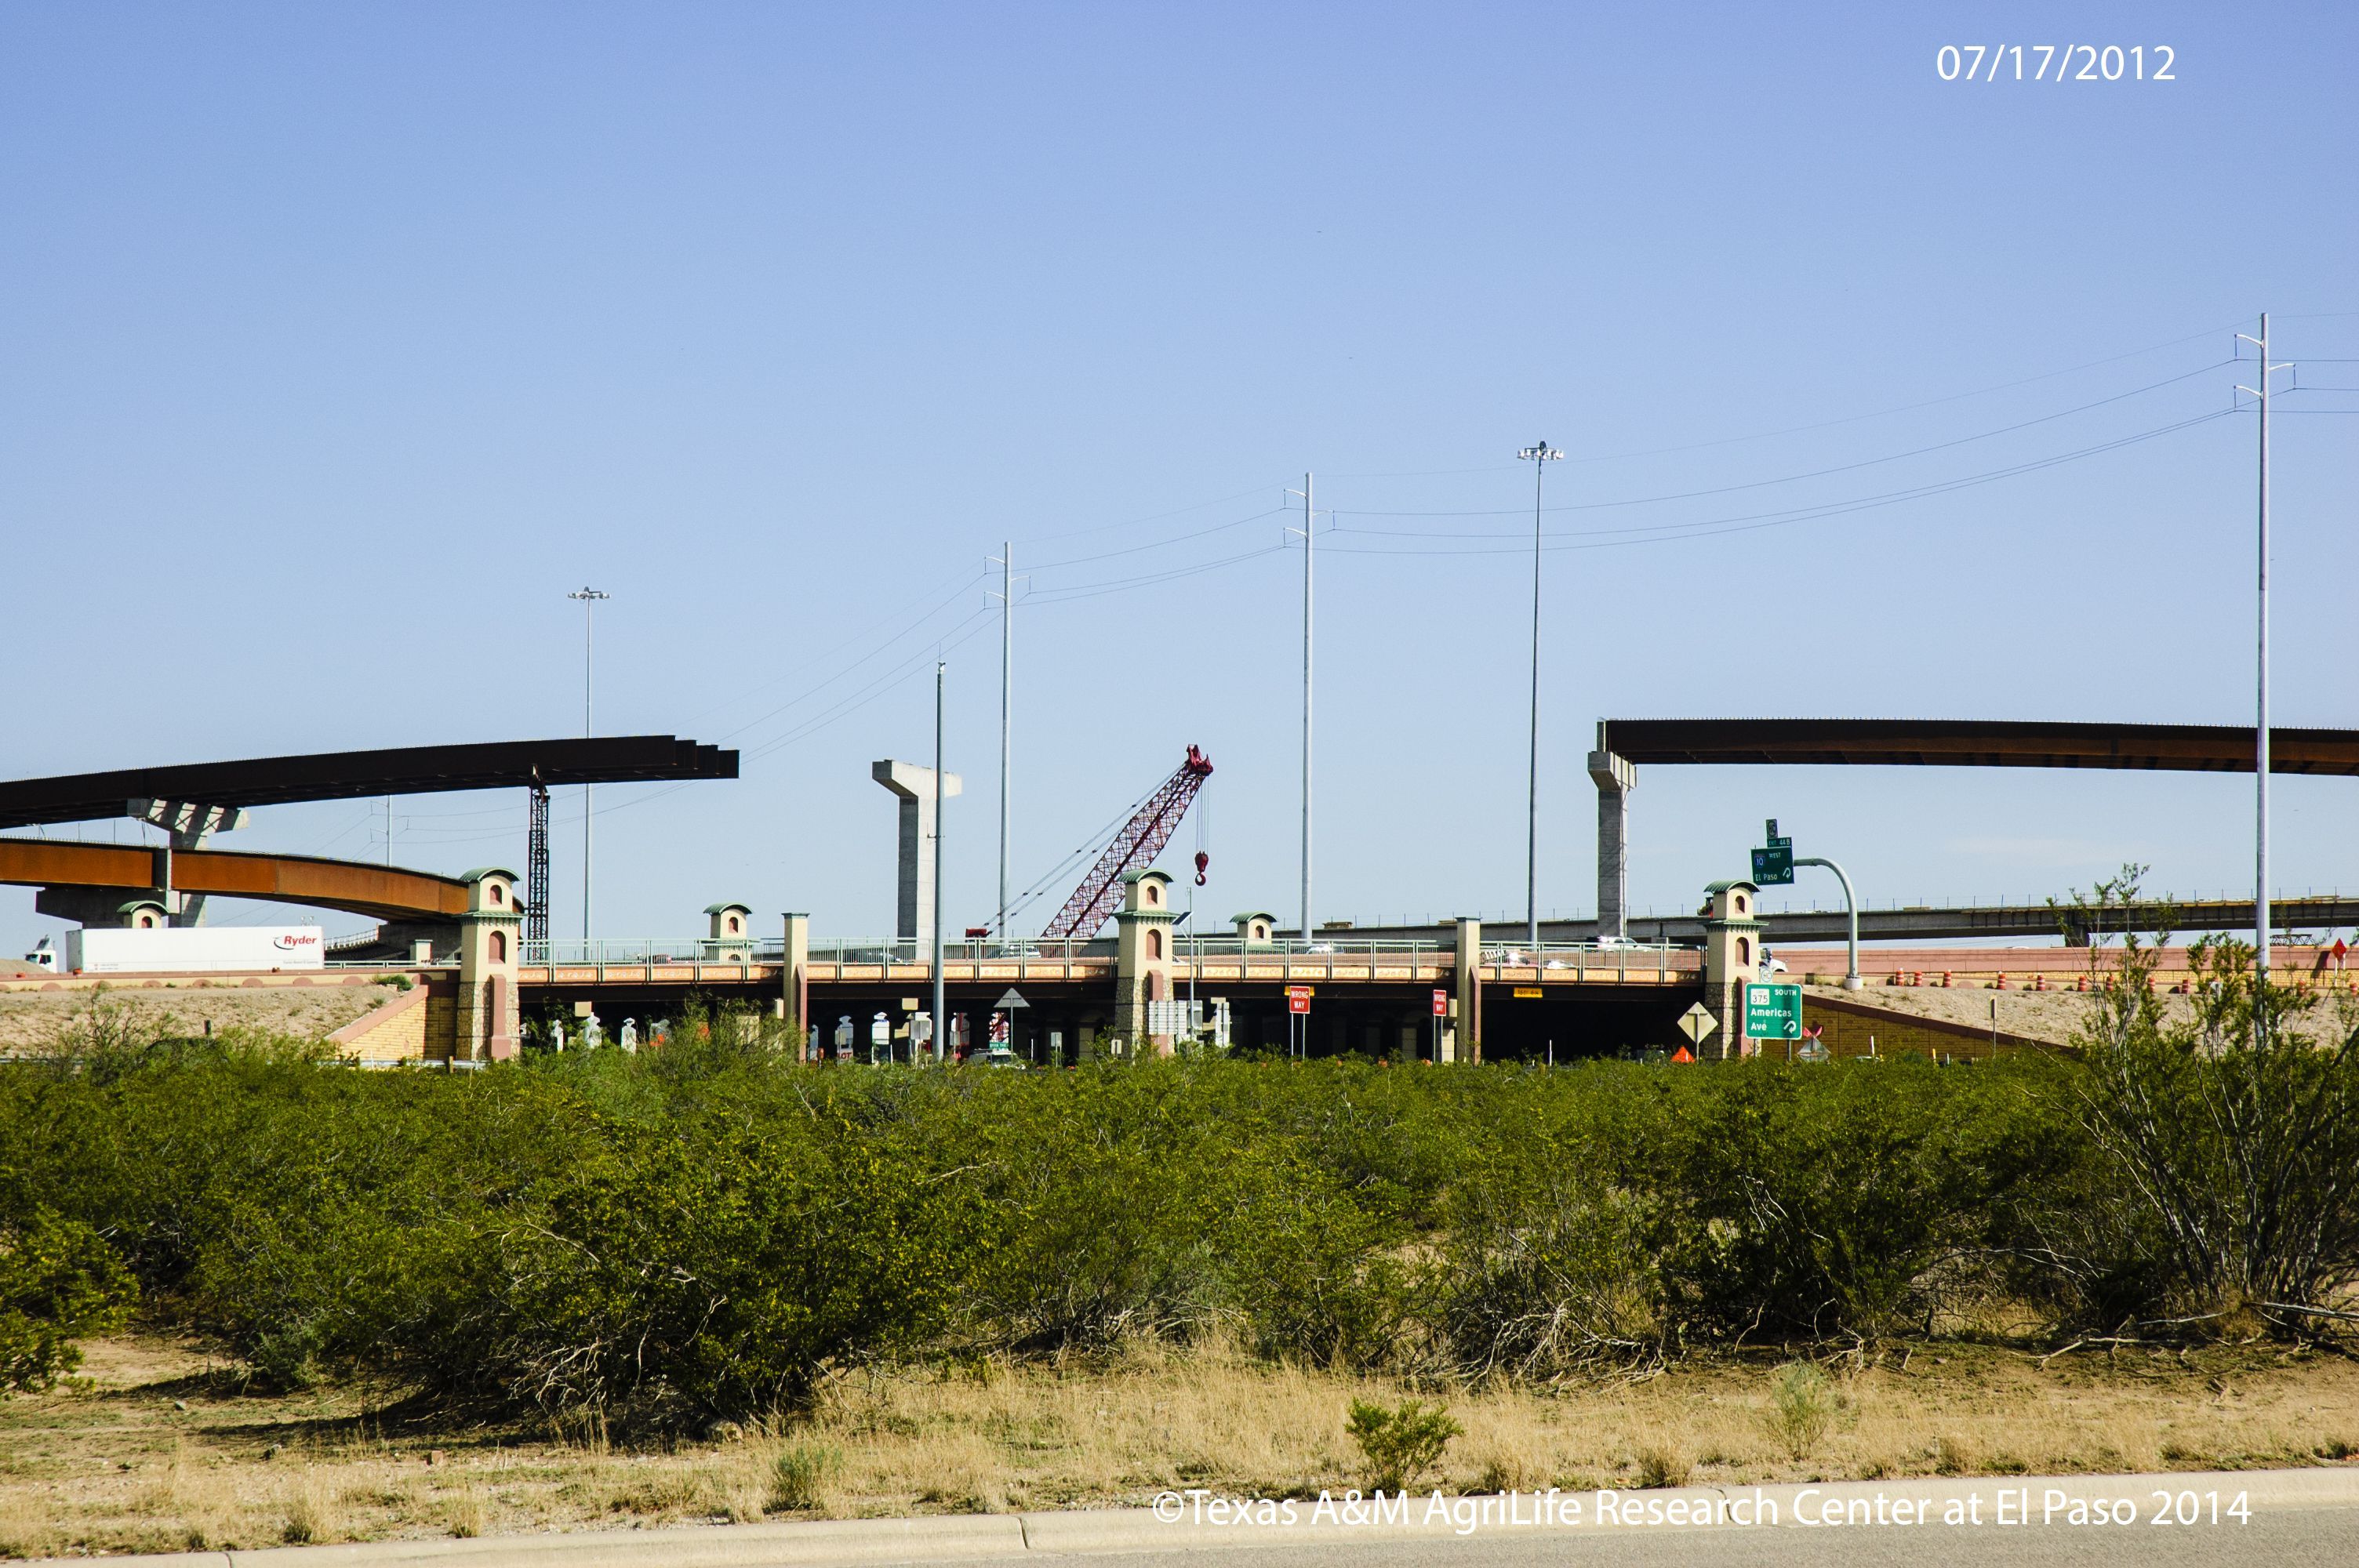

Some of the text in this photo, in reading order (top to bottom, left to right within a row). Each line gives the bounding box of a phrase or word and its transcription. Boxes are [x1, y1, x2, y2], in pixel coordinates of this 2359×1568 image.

[1756, 858, 1764, 866] 10
[284, 935, 317, 946] Ryder
[1752, 995, 1768, 1004] 375
[1294, 1000, 1305, 1009] WAY
[1750, 1007, 1792, 1018] Americas
[1750, 1022, 1767, 1031] Ave
